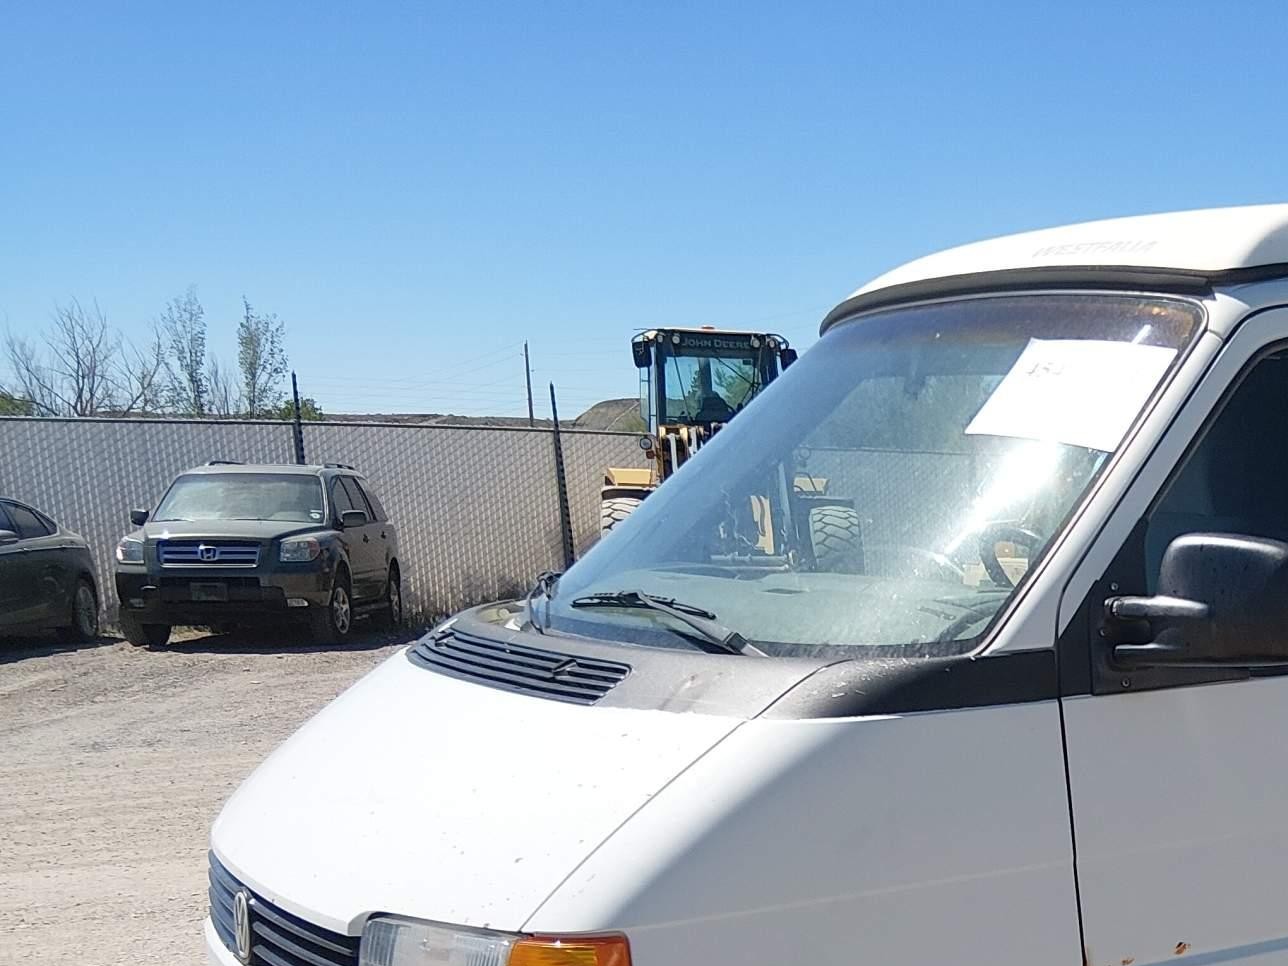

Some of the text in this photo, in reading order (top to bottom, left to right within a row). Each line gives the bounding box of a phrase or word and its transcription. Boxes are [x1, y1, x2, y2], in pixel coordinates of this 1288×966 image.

[1031, 240, 1159, 258] WESTFALIA
[681, 337, 751, 350] JOHN DEERE
